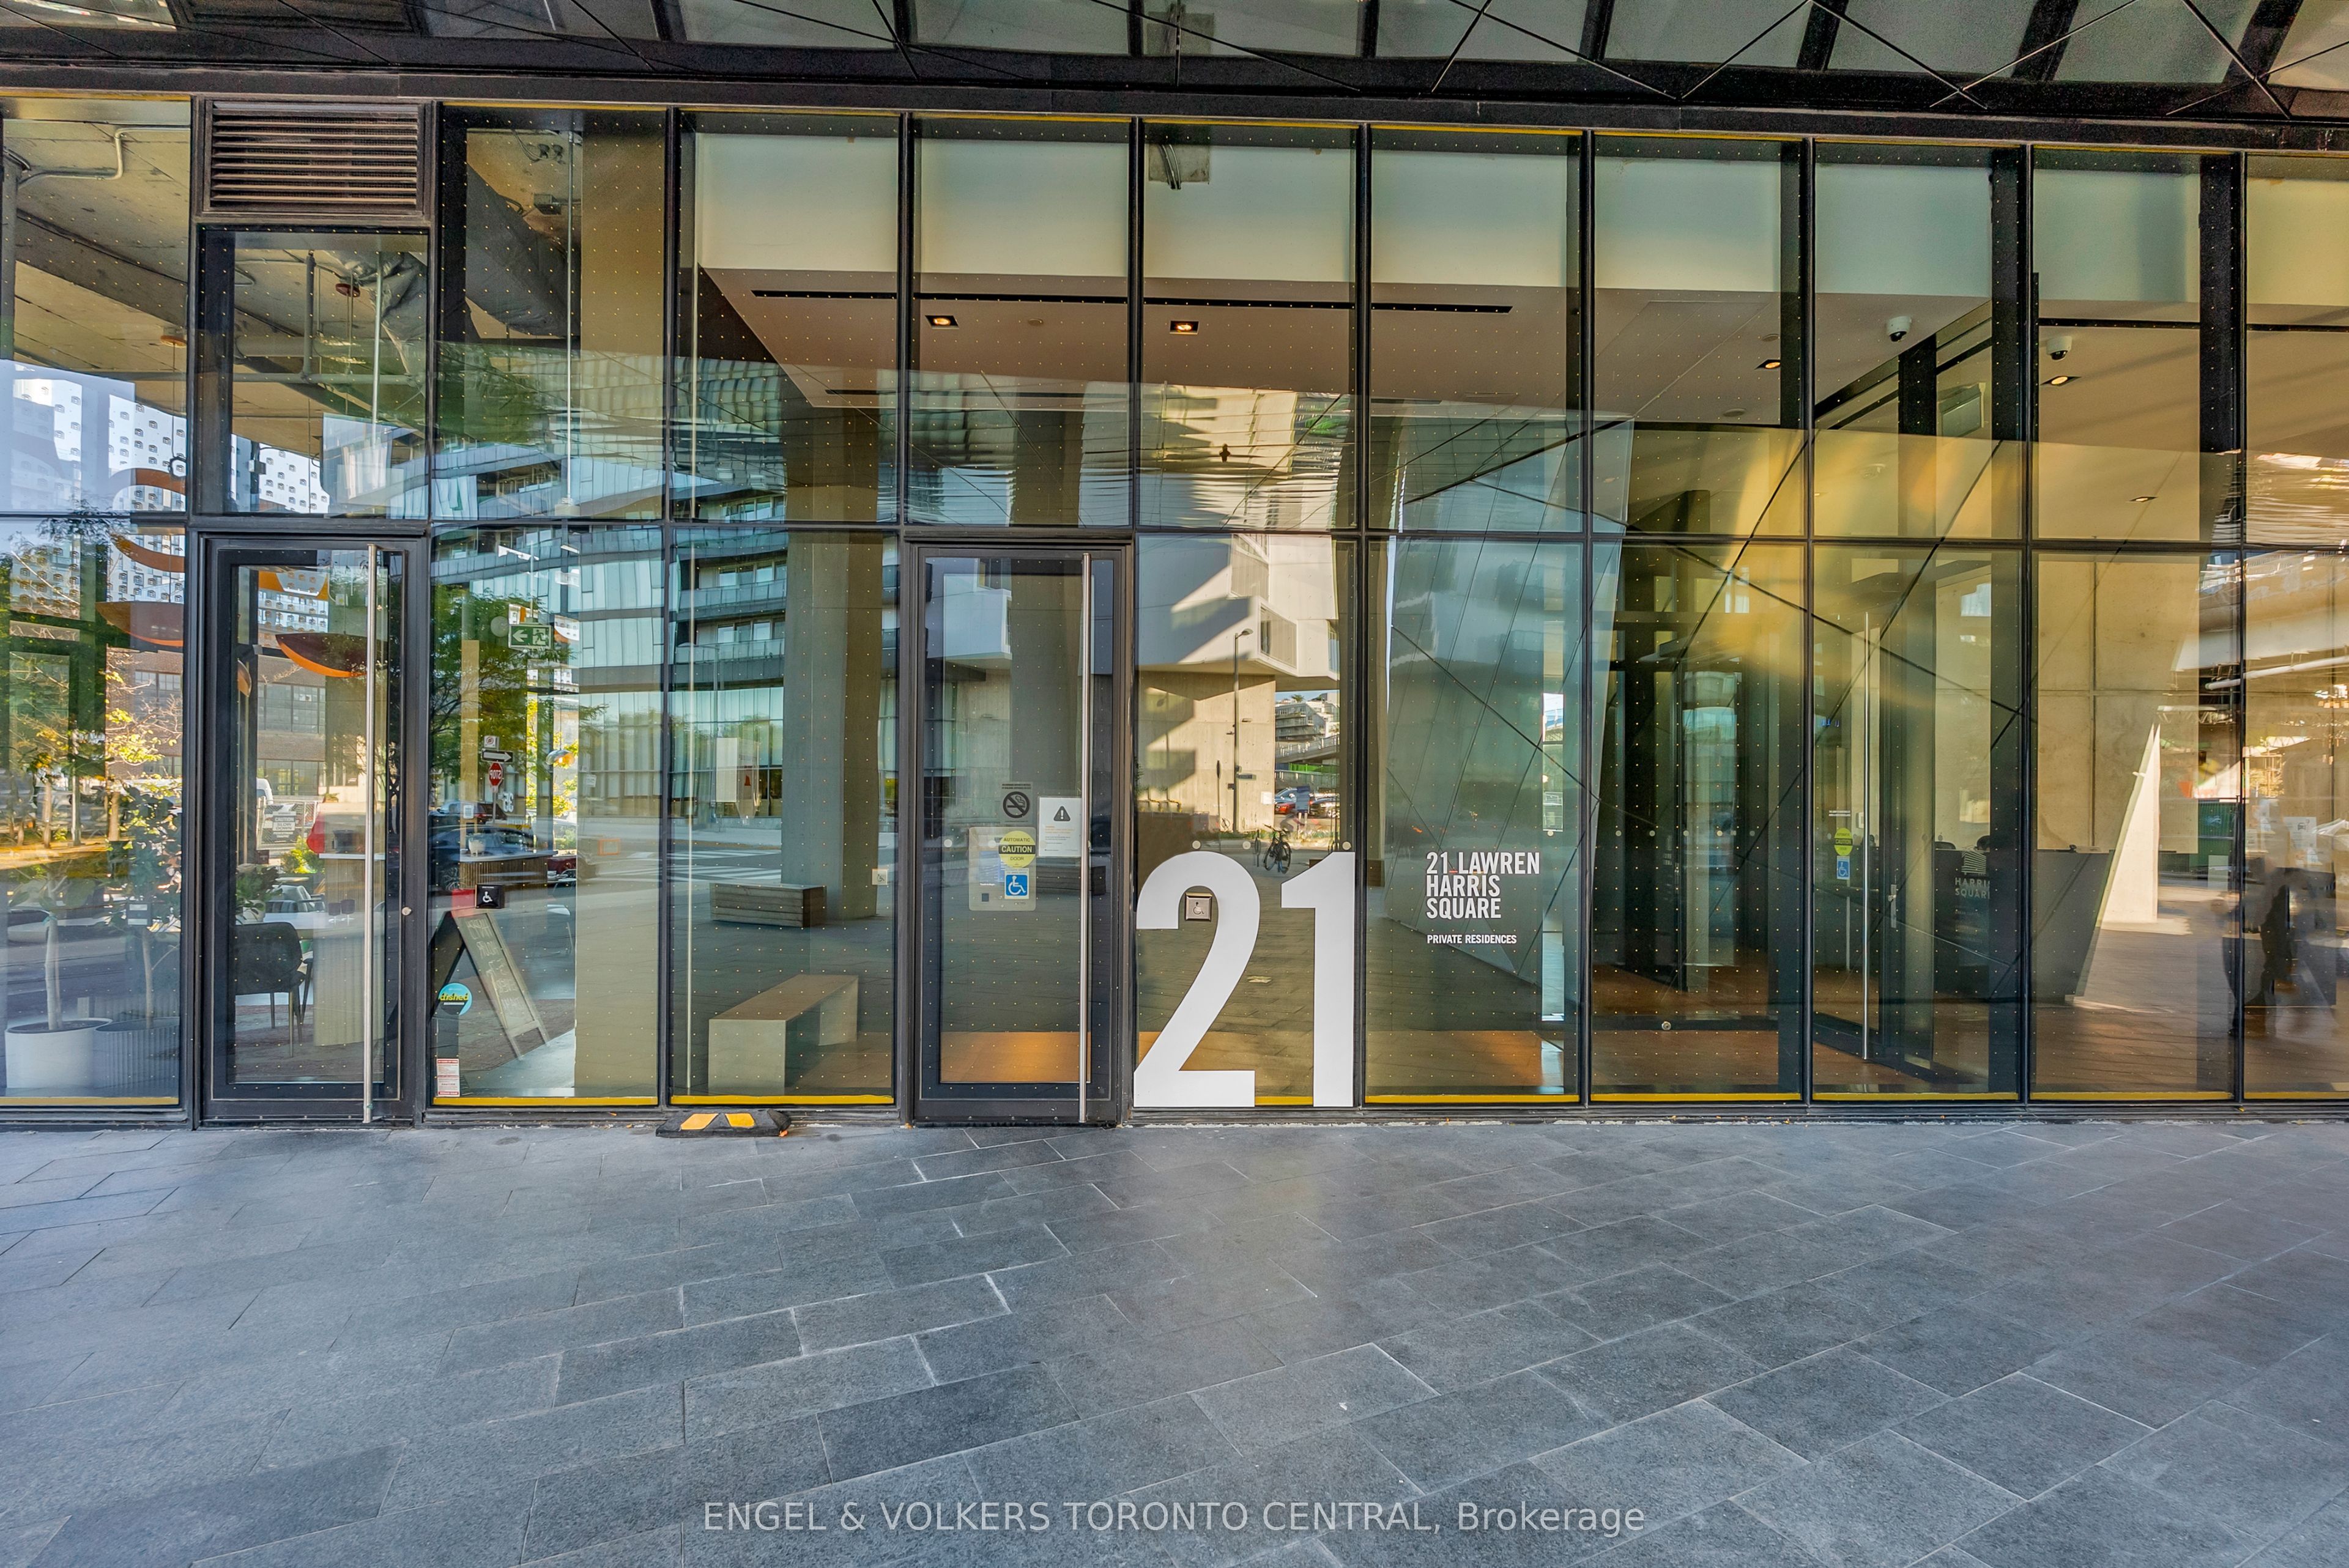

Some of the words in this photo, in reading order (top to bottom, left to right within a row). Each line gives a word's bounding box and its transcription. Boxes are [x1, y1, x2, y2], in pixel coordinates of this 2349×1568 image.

[1427, 852, 1448, 874] 21
[1458, 852, 1540, 874] LAWREN
[1427, 875, 1501, 897] HARRIS
[1427, 898, 1502, 920] SQUARE
[1427, 934, 1463, 944] PRIVATE
[1465, 934, 1517, 944] RESIDENCES
[1134, 851, 1355, 1107] 21
[440, 993, 469, 1001] dished
